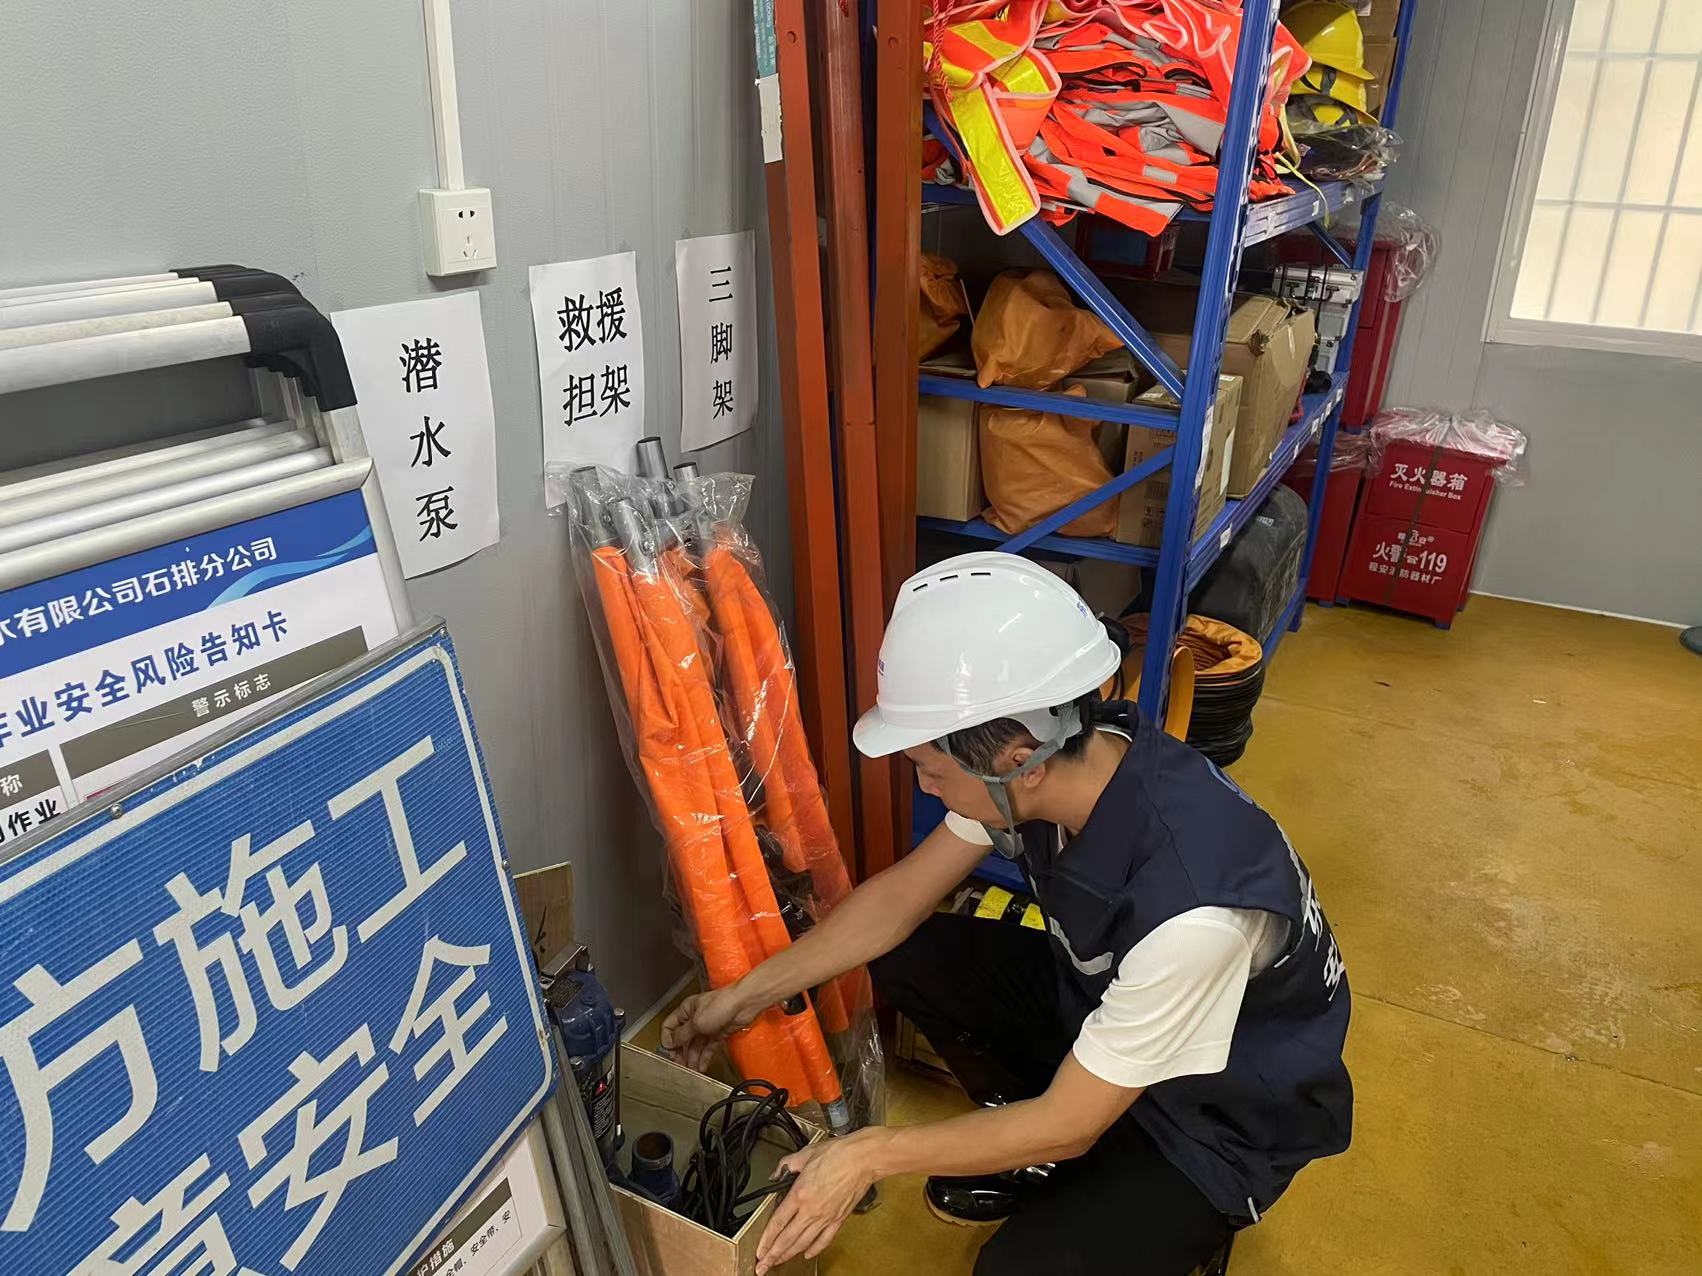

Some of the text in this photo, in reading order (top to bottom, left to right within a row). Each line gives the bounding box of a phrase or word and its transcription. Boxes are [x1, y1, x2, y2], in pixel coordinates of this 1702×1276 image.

[557, 286, 629, 352] 救援
[708, 265, 735, 420] 三脚架
[562, 363, 632, 427] 担架
[399, 336, 459, 542] 潜水泵
[1389, 481, 1461, 500] Fire Extinuisher Box
[1390, 463, 1468, 491] 灭火器箱
[1419, 550, 1447, 573] 119
[191, 672, 271, 718] 警示标志
[0, 774, 23, 796] 称
[0, 799, 60, 843] 作业
[0, 735, 467, 1232] 方施工
